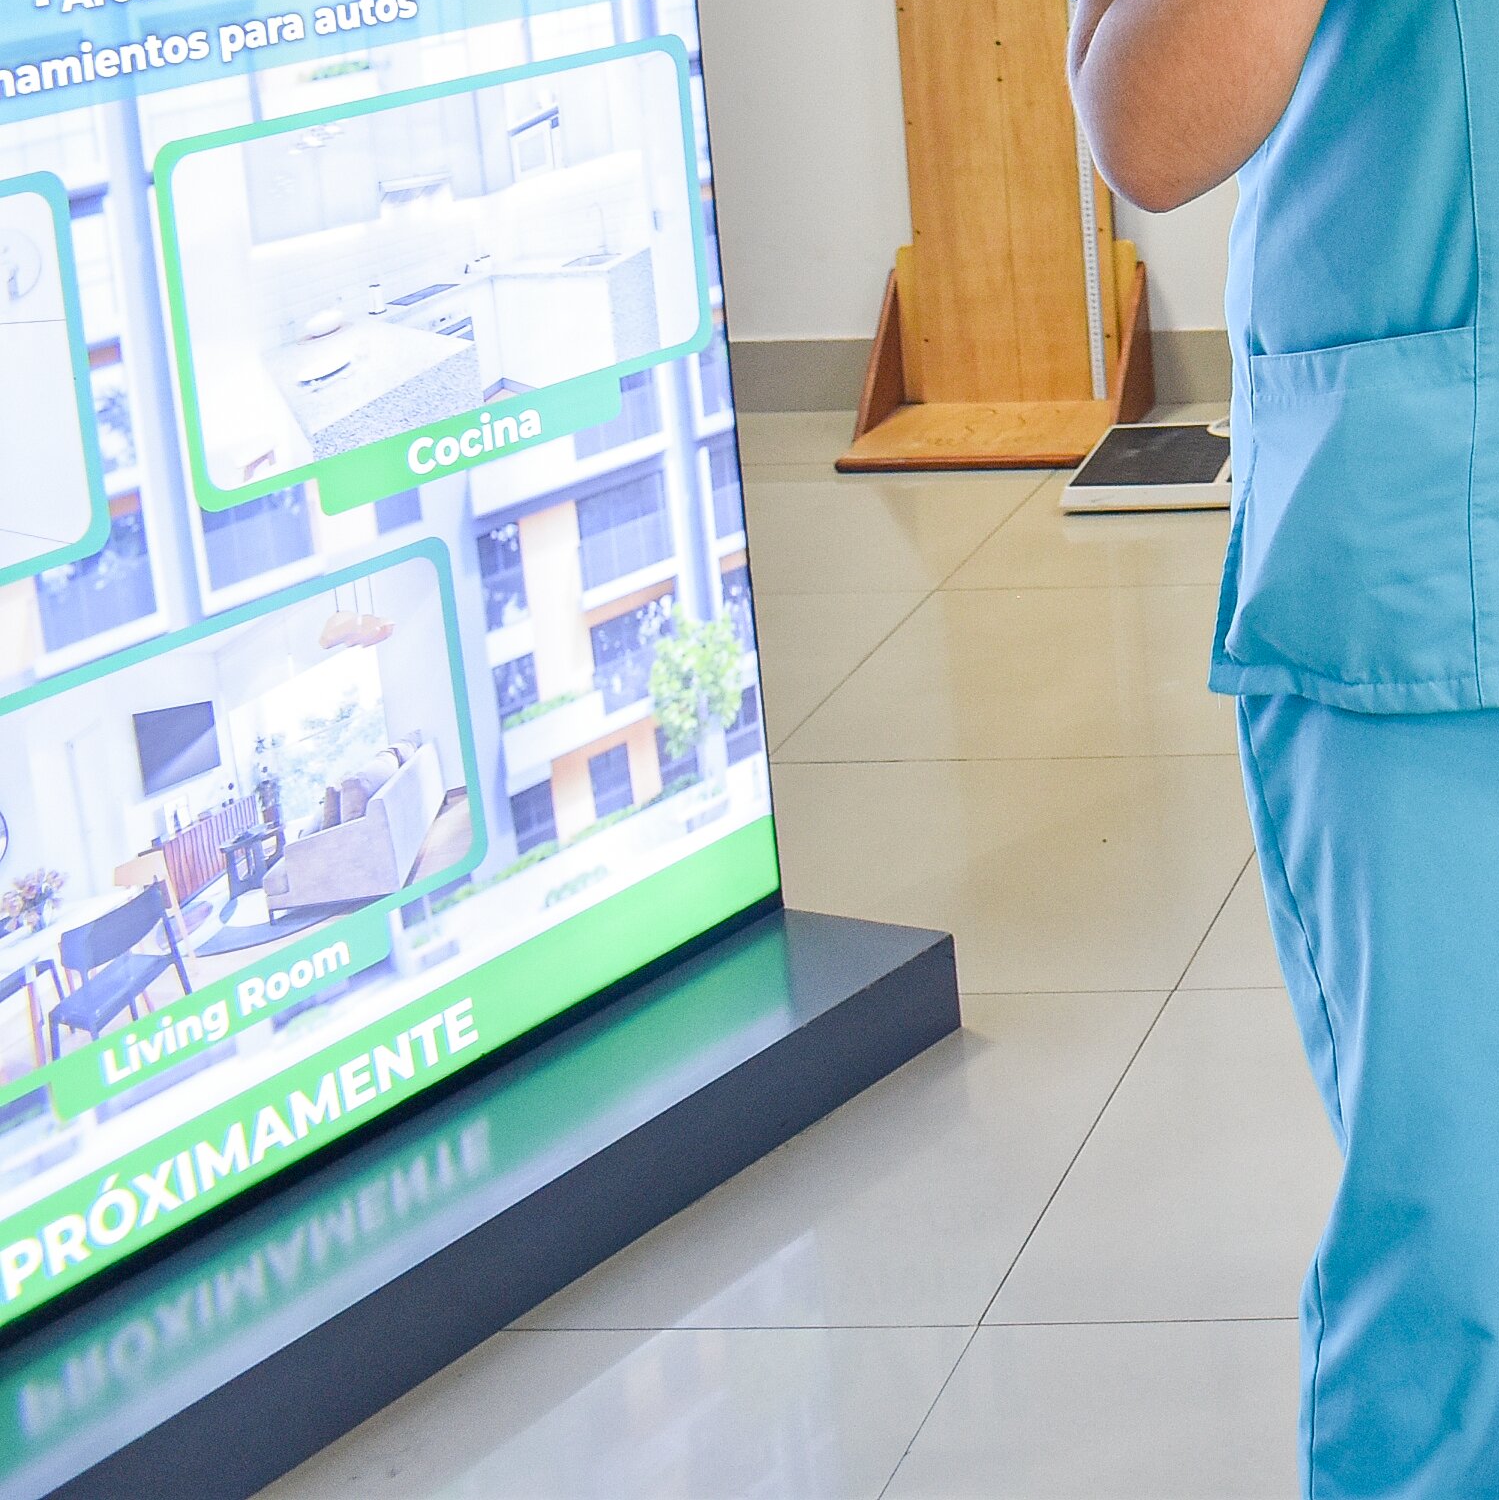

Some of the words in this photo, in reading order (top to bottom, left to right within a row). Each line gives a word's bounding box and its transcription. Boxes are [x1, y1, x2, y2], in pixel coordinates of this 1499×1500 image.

[219, 12, 305, 63] para
[407, 408, 543, 476] Cocina
[101, 999, 230, 1087] Living
[236, 939, 351, 1017] Room
[0, 997, 481, 1302] PRÓXIMAMENTE
